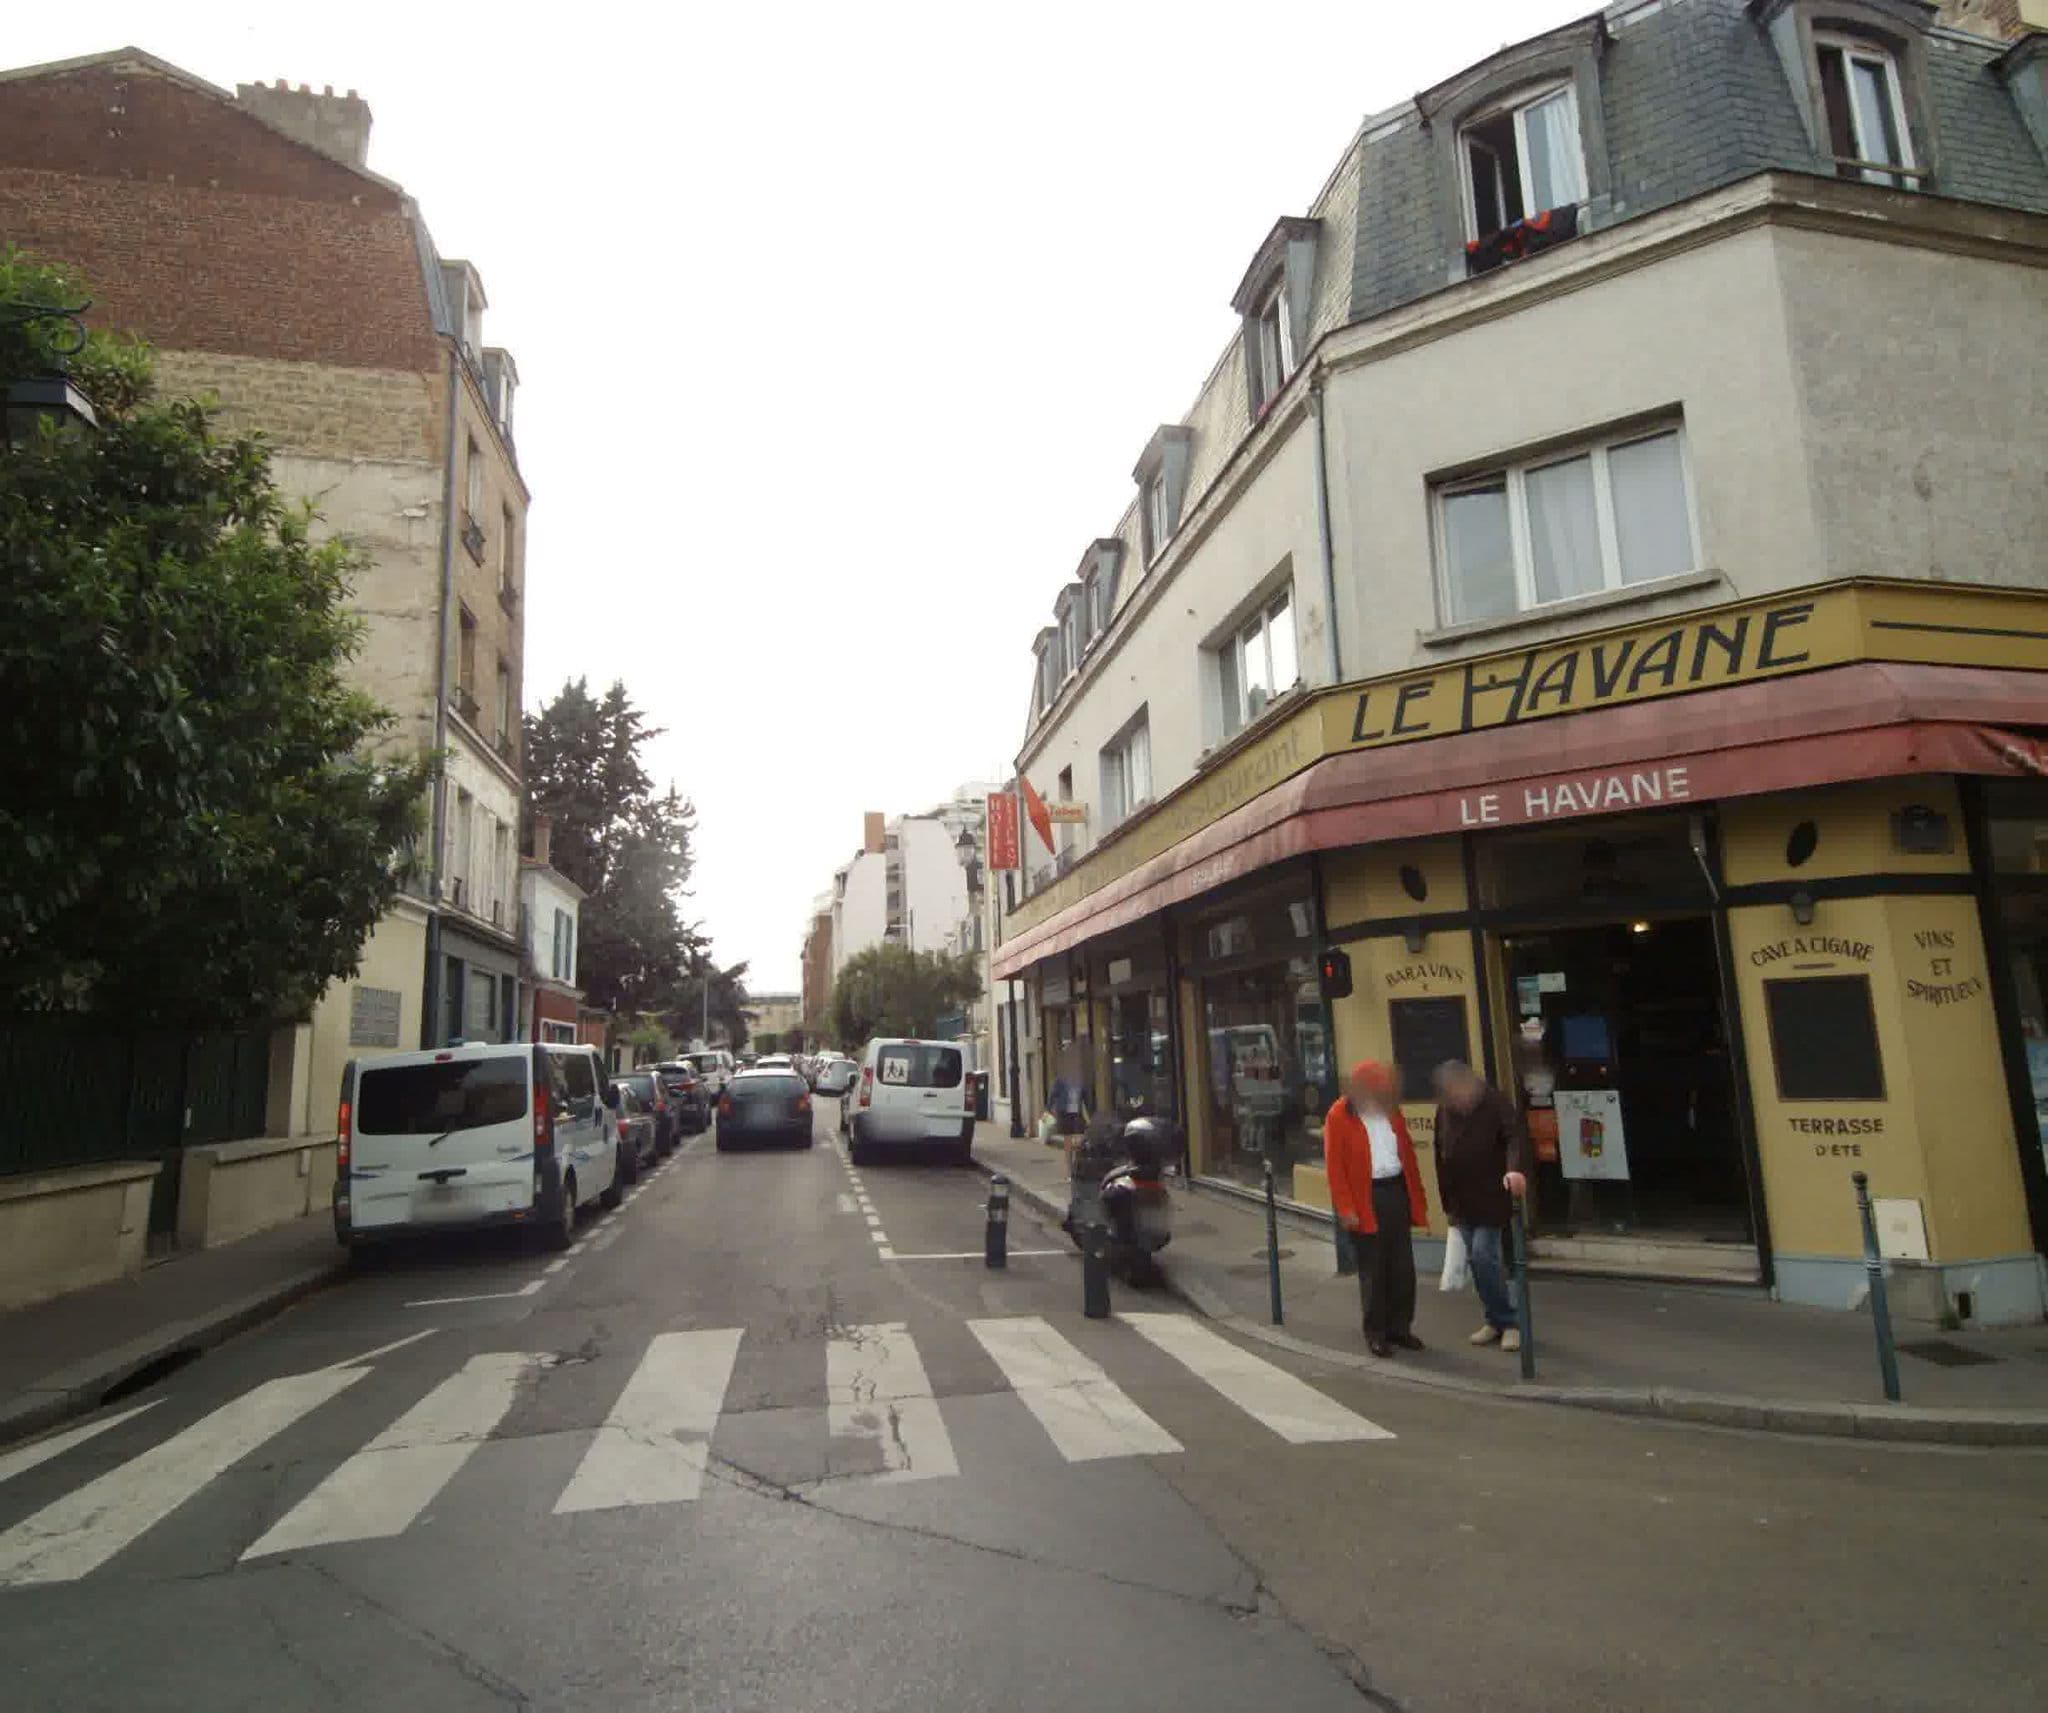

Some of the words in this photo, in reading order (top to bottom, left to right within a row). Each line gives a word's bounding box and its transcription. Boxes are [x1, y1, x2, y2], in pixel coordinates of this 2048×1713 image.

[1351, 681, 1435, 743] LE
[1460, 603, 1815, 733] HAVANE
[1460, 794, 1501, 826] LE
[1523, 767, 1691, 818] HAVANE
[1751, 941, 1791, 966] CAVE
[1809, 937, 1875, 962] CIGARE
[1913, 930, 1955, 950] VINS
[1930, 958, 1953, 977] ET
[1788, 1117, 1884, 1135] TERRASSE
